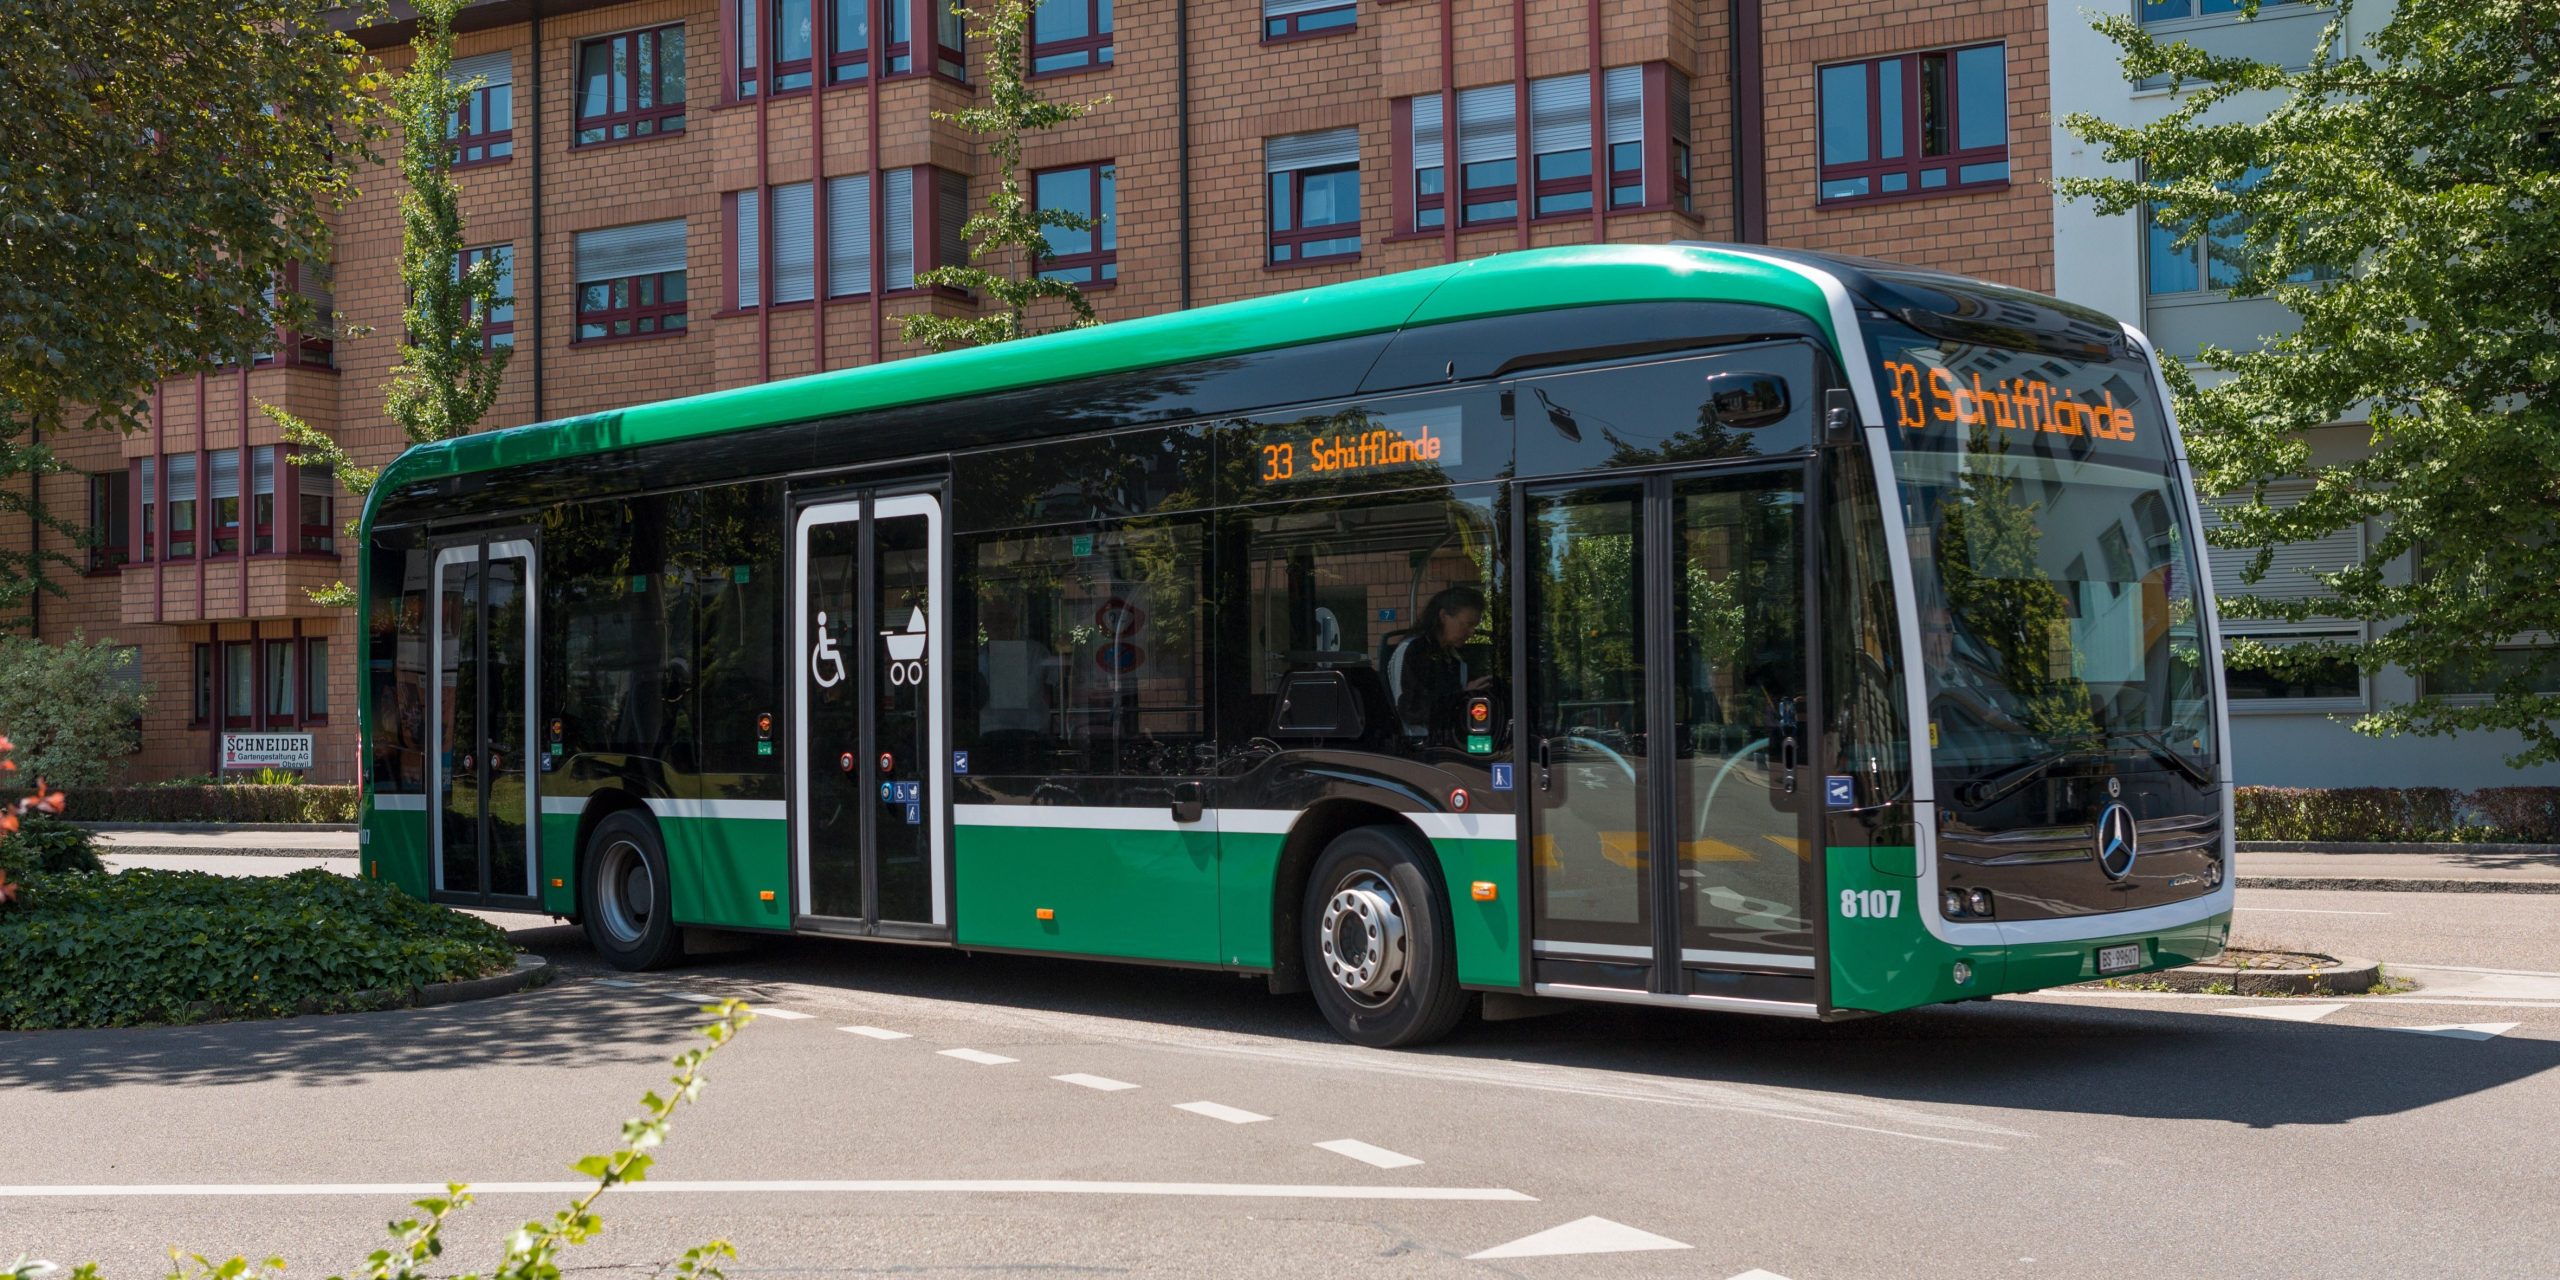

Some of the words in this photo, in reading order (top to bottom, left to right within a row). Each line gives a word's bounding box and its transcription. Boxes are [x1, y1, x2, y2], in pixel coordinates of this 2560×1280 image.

[1883, 360, 1926, 428] 33
[1927, 366, 2137, 442] Schifflände
[1263, 443, 1293, 481] 33
[1311, 425, 1441, 472] Schifflände
[227, 737, 309, 752] SCHNEIDER
[237, 753, 296, 762] Gartengestaltung
[1840, 888, 1902, 919] 8107
